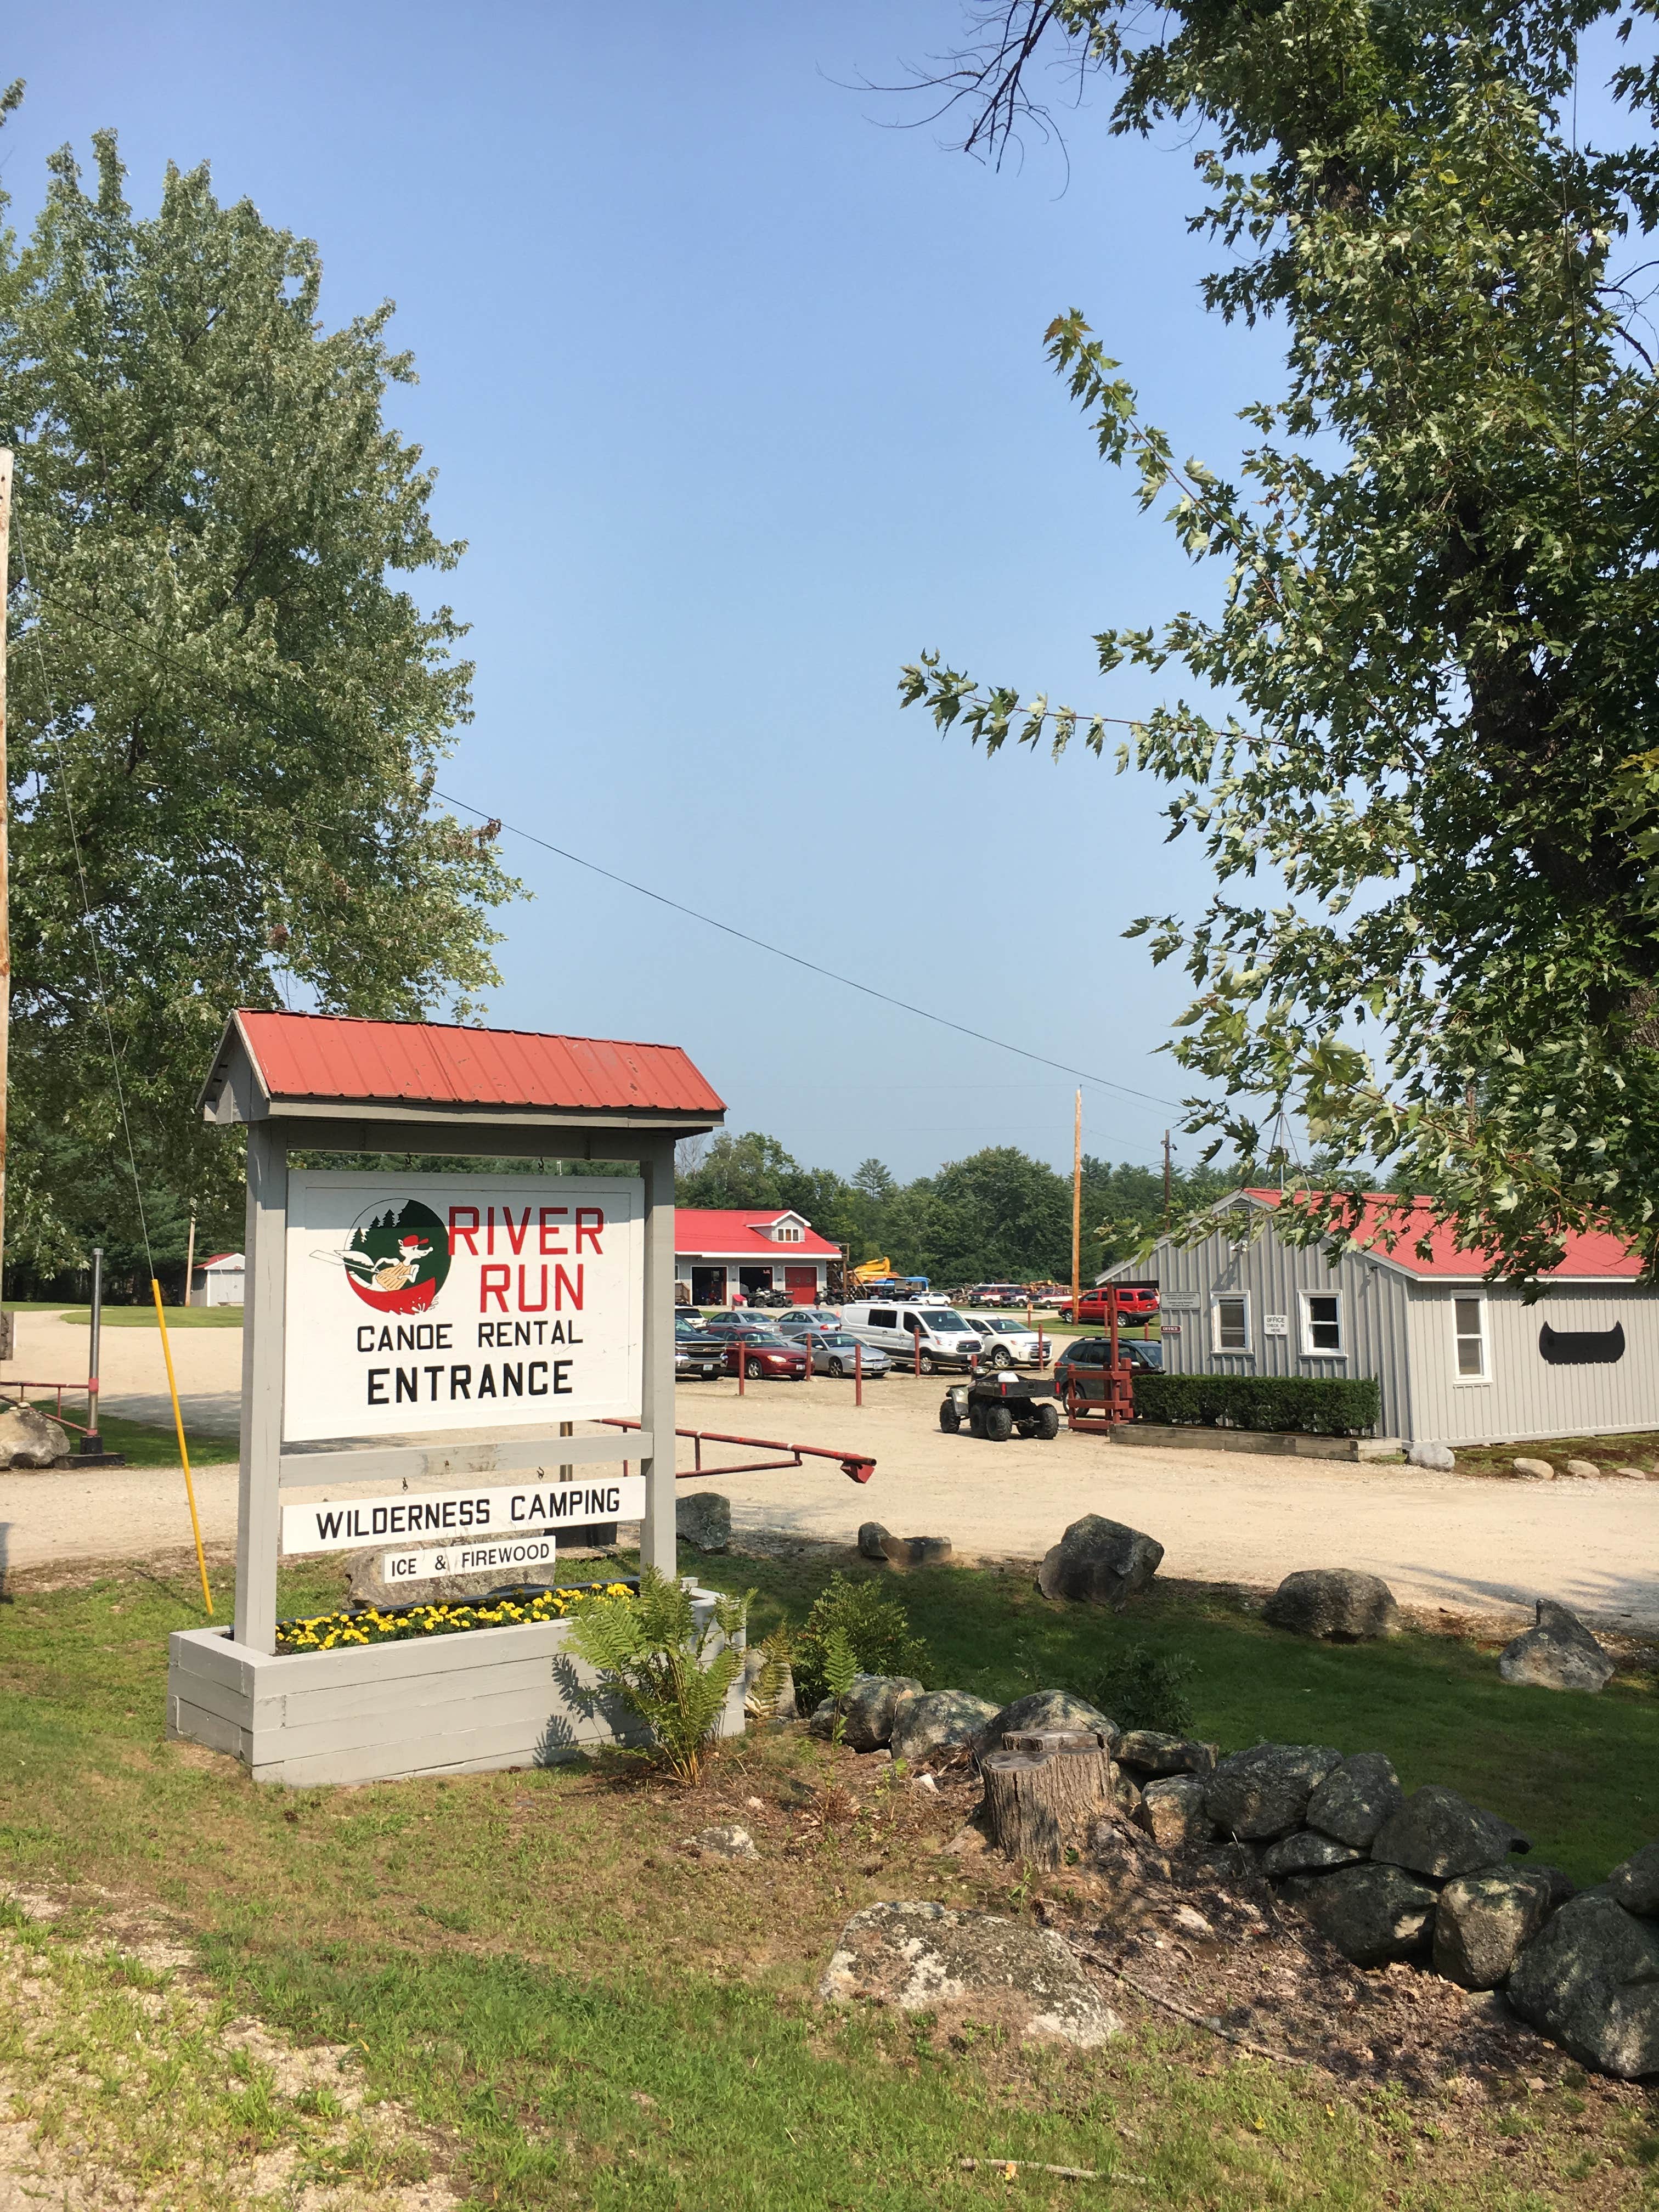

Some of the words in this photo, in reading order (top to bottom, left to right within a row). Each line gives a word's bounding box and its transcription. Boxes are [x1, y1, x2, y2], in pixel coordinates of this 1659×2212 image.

[448, 1206, 603, 1256] RIVER
[480, 1263, 584, 1313] RUN
[357, 1323, 453, 1352] CANOE
[478, 1320, 583, 1347] RENTAL
[368, 1359, 573, 1405] ENTRANCE
[316, 1499, 490, 1539] WILDERNESS
[511, 1487, 619, 1521] CAMPING
[392, 1558, 416, 1577] ICE
[435, 1555, 446, 1570] &
[462, 1543, 549, 1568] FIREWOOD
